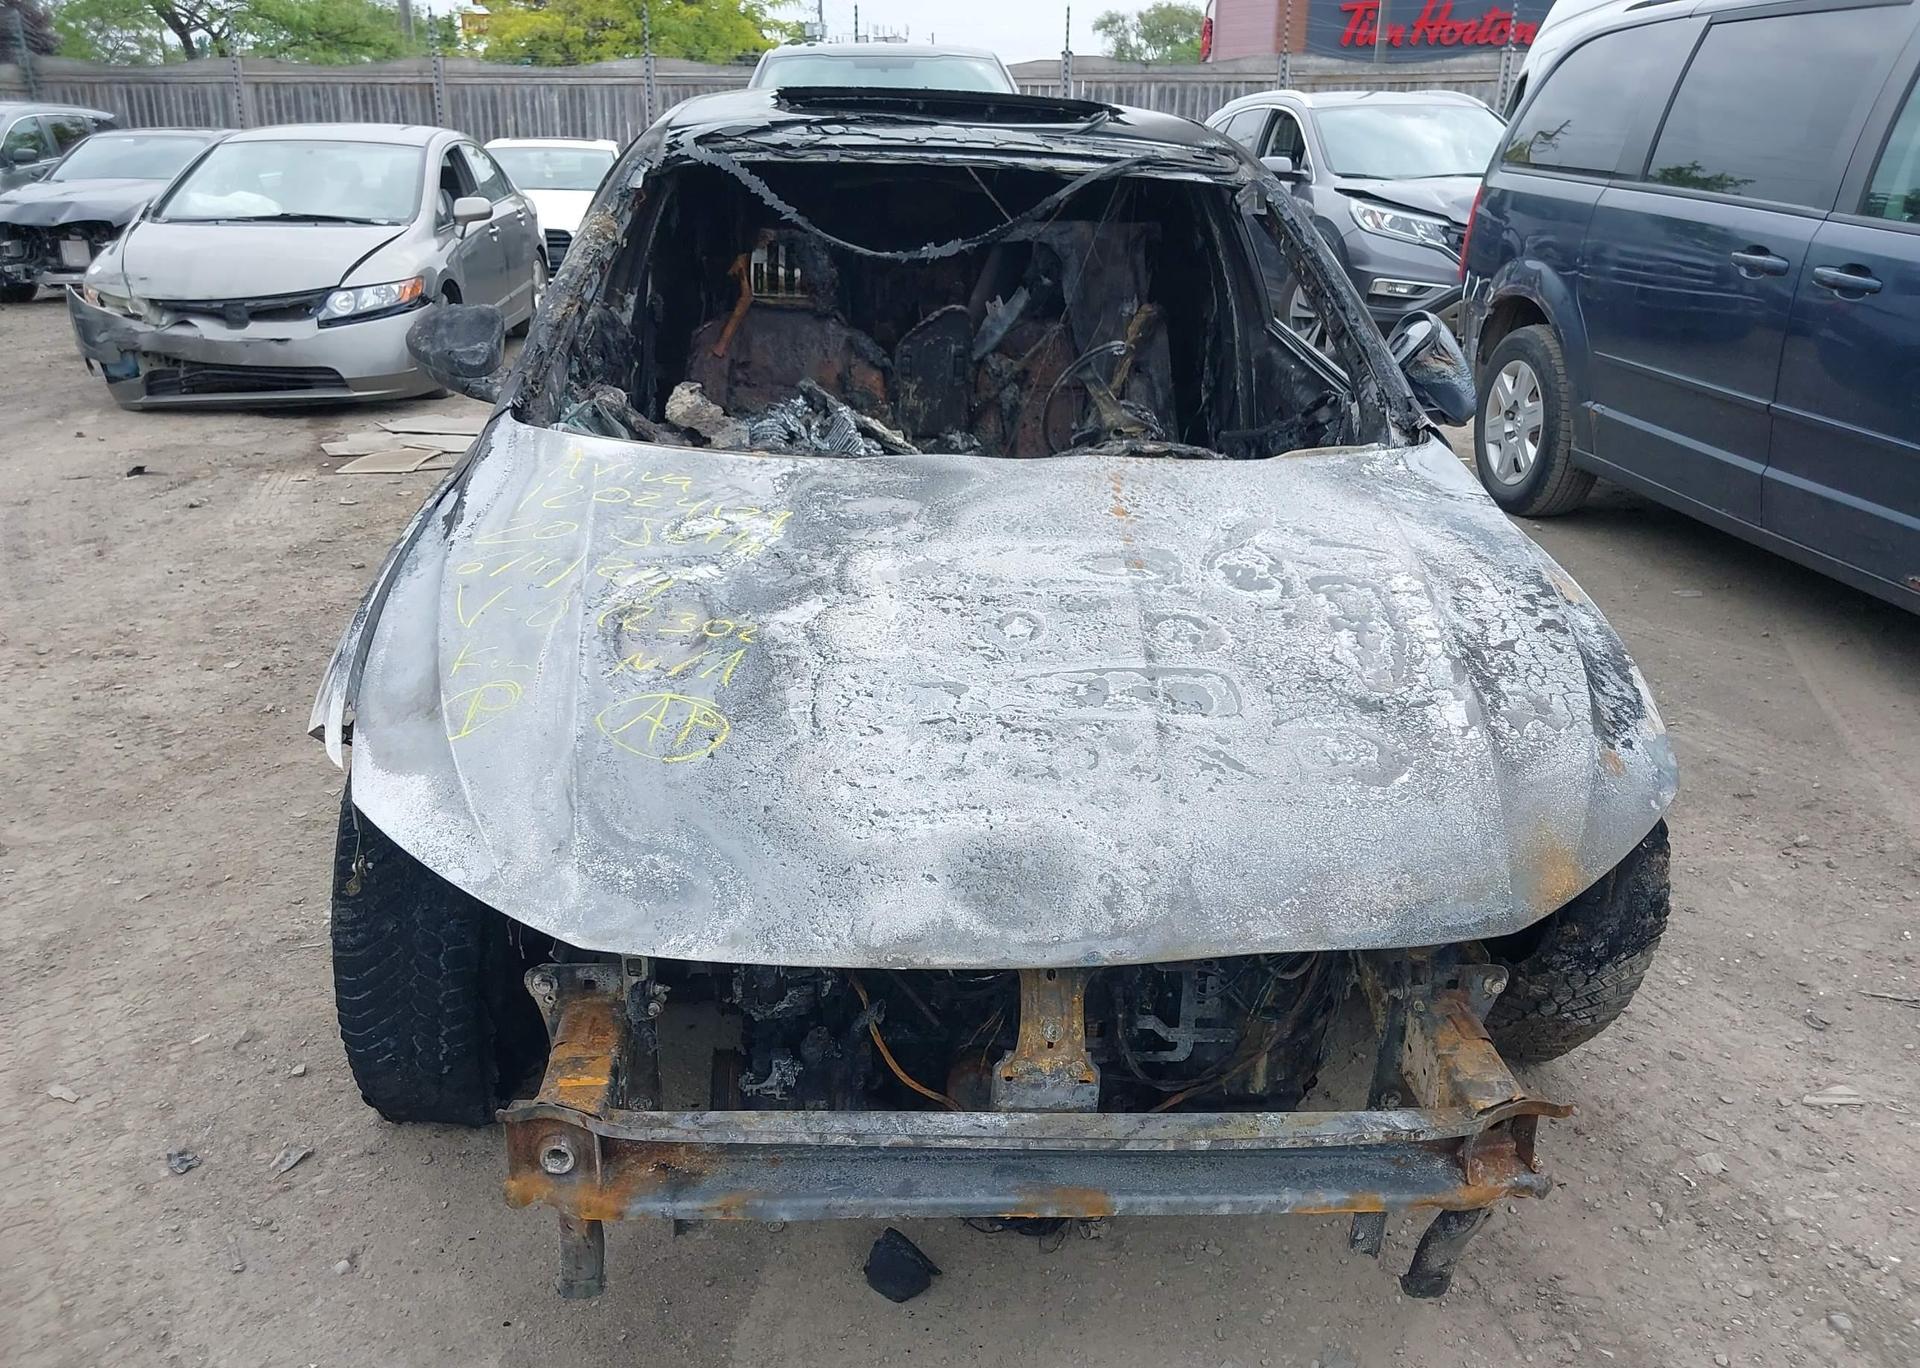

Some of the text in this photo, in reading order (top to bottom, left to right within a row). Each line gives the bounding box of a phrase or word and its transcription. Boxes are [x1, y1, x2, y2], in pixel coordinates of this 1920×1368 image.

[1339, 0, 1537, 48] Tim Horton
[548, 447, 693, 493] Aviva
